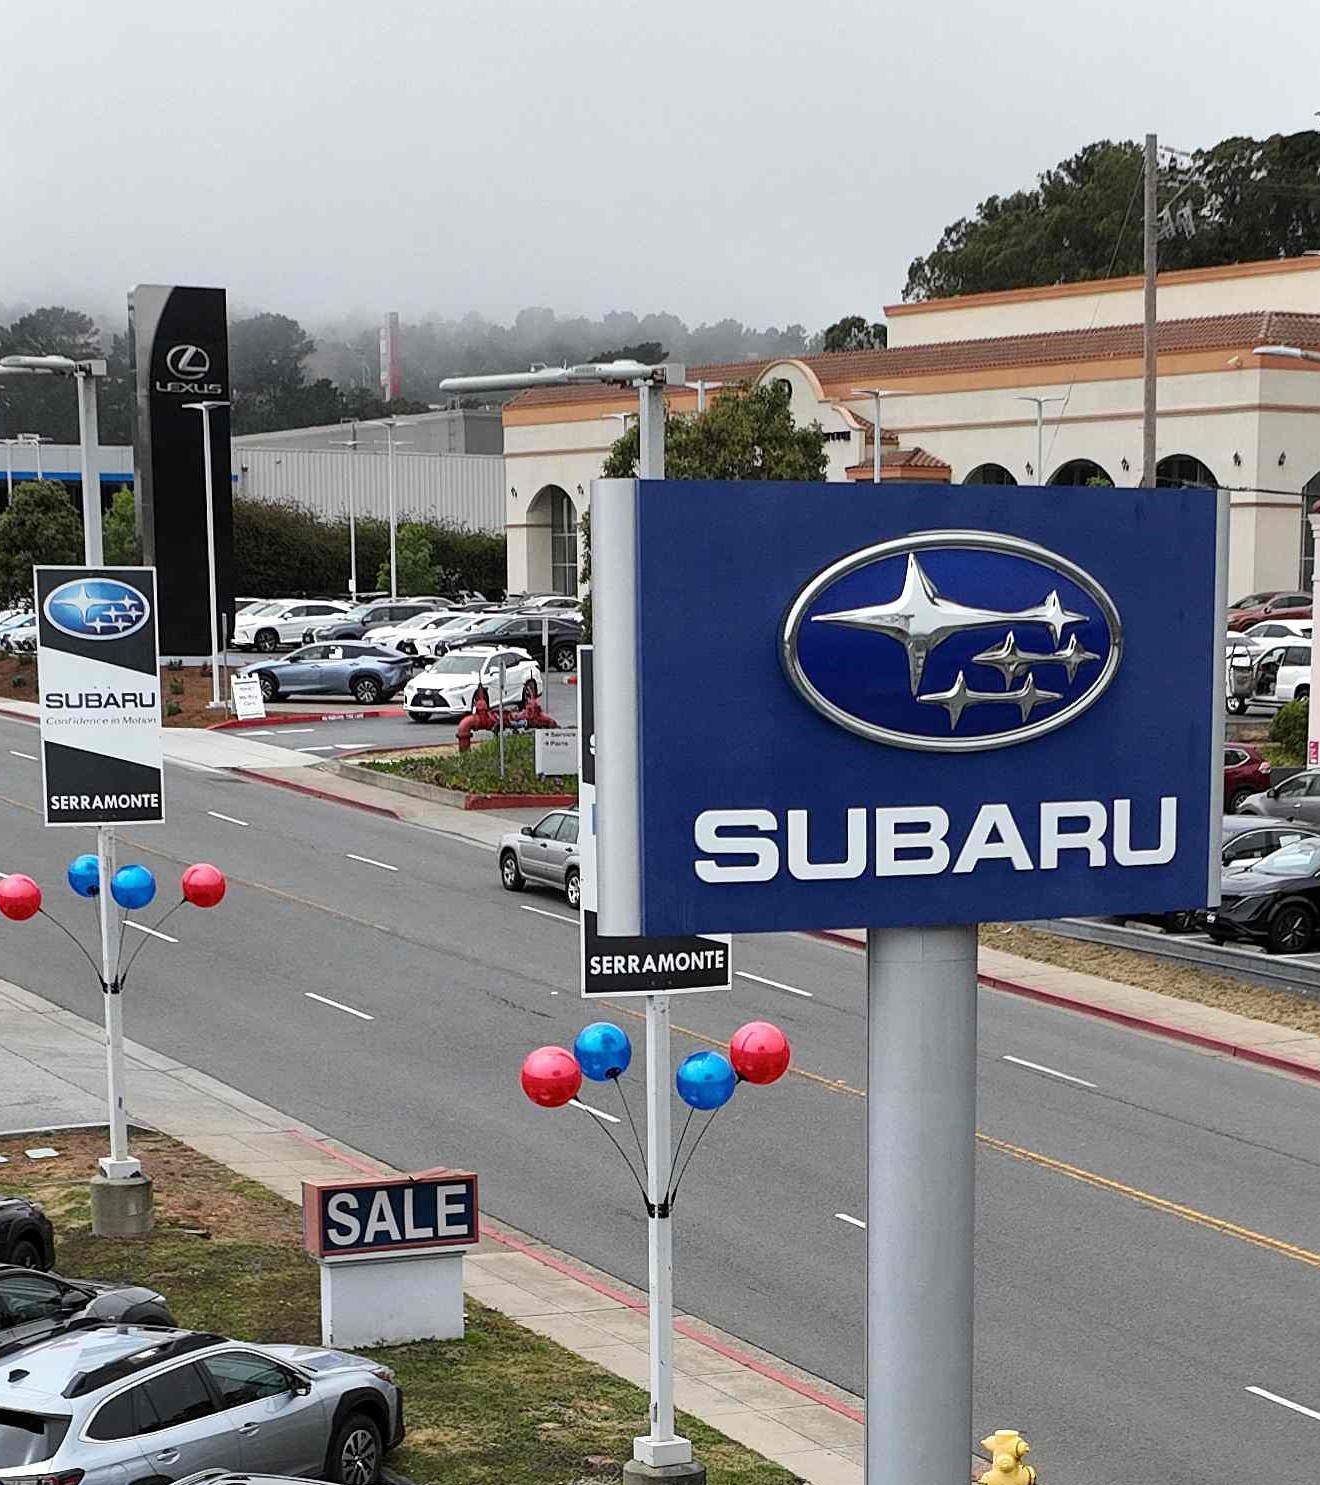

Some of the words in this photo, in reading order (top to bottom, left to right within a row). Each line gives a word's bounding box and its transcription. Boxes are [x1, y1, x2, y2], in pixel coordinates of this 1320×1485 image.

[156, 381, 222, 394] LEXUS
[45, 692, 156, 709] SUBARU
[46, 717, 109, 726] Confidence
[122, 716, 157, 726] Motion
[51, 793, 159, 811] SERRAMONTE
[694, 797, 1178, 884] SUBARU
[590, 950, 725, 976] SERRAMONTE
[327, 1184, 470, 1246] SALE
